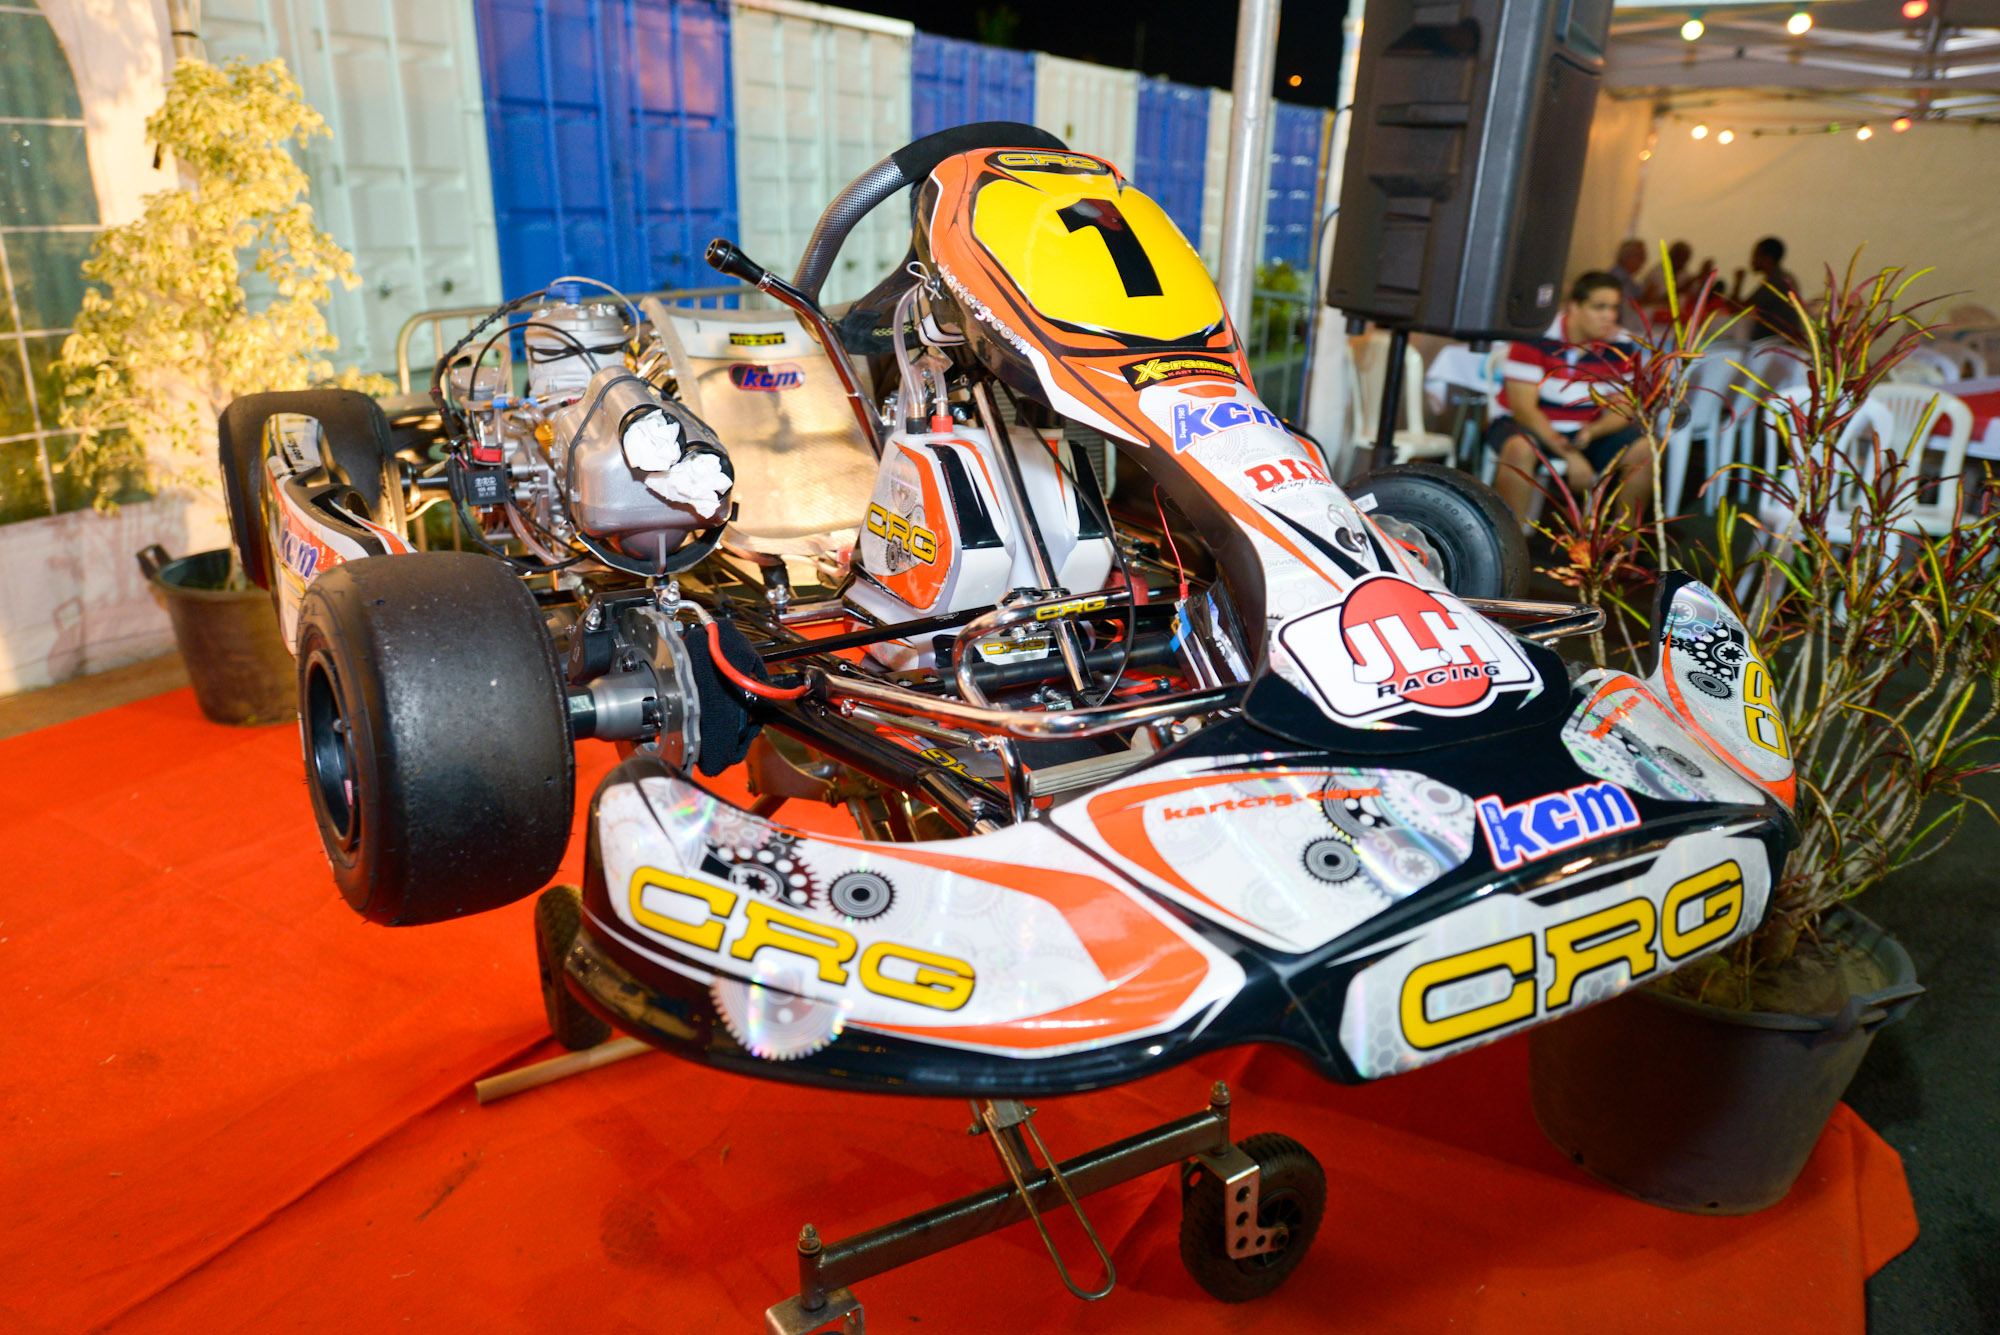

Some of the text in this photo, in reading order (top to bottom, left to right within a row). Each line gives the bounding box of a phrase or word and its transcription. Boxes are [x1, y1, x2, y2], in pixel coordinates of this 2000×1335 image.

[998, 153, 1102, 170] CRG
[1056, 197, 1164, 298] 1
[743, 367, 798, 388] kcm
[1173, 401, 1294, 452] kcm
[866, 501, 937, 565] CRG
[1036, 596, 1106, 621] CRG
[982, 638, 1045, 655] CRG
[1376, 664, 1501, 699] RACING
[1743, 636, 1790, 761] CR
[1163, 787, 1382, 821] kartcrg.com
[1480, 782, 1637, 865] kcm
[629, 865, 976, 1012] CRG
[1398, 857, 1744, 1052] CRG
